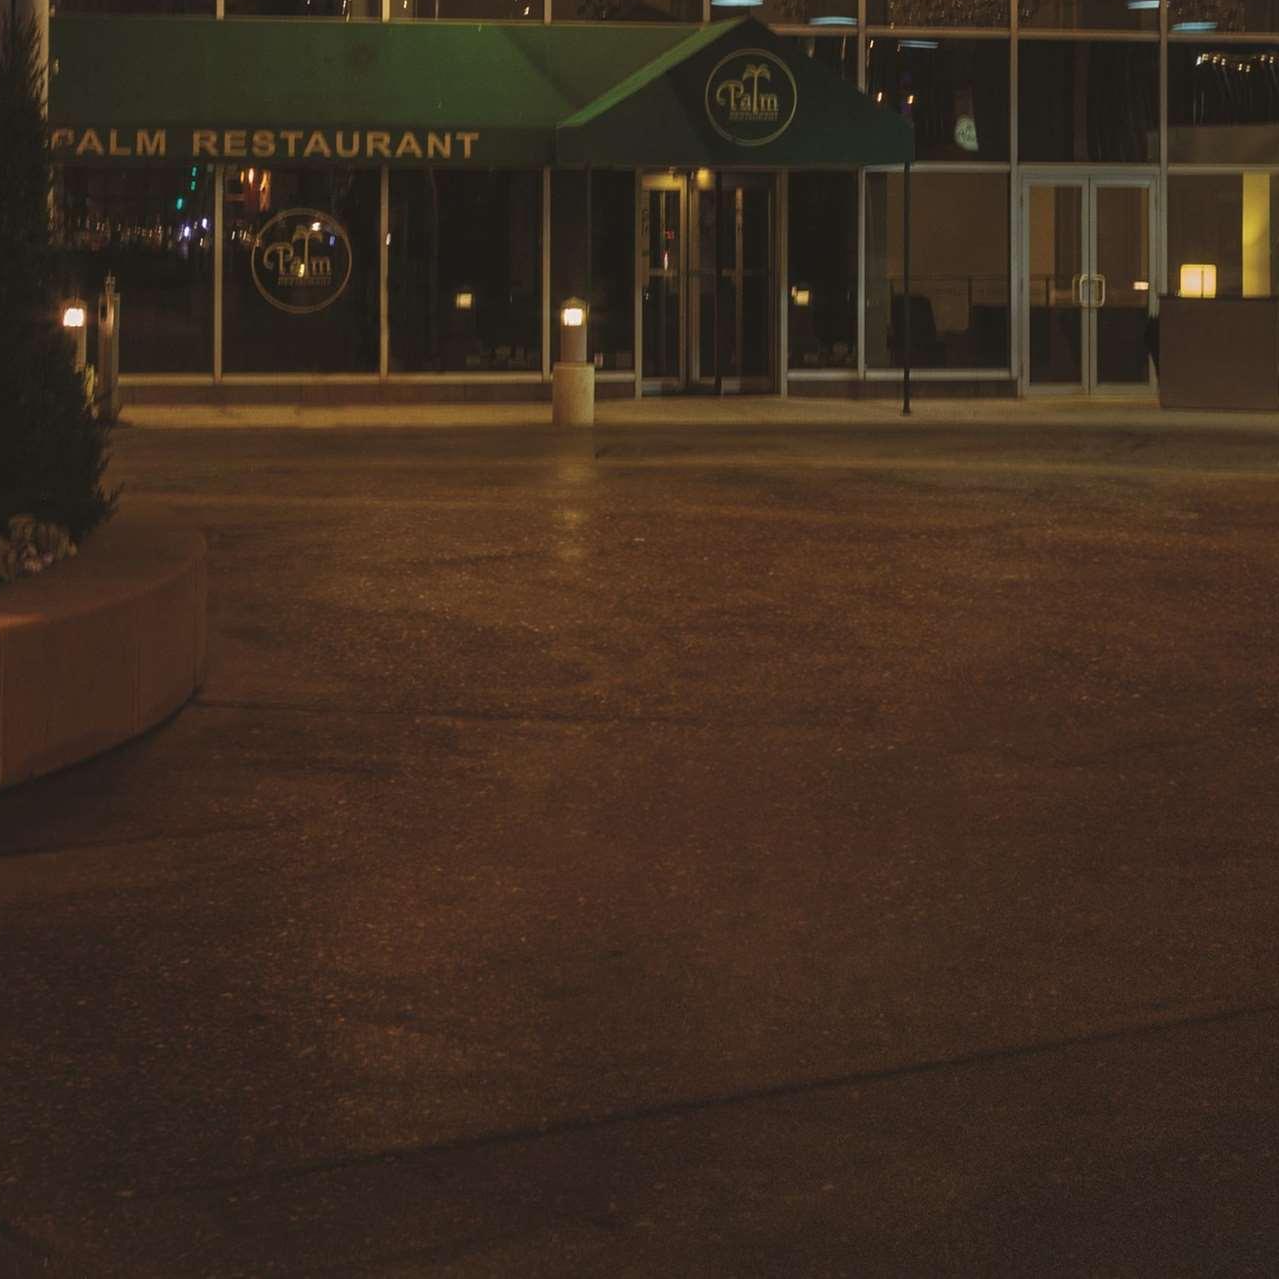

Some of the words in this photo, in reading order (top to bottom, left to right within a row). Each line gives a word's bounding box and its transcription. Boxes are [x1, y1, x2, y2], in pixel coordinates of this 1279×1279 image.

[716, 64, 778, 112] Palm
[192, 130, 480, 159] RESTAURANT
[263, 225, 332, 277] Palm
